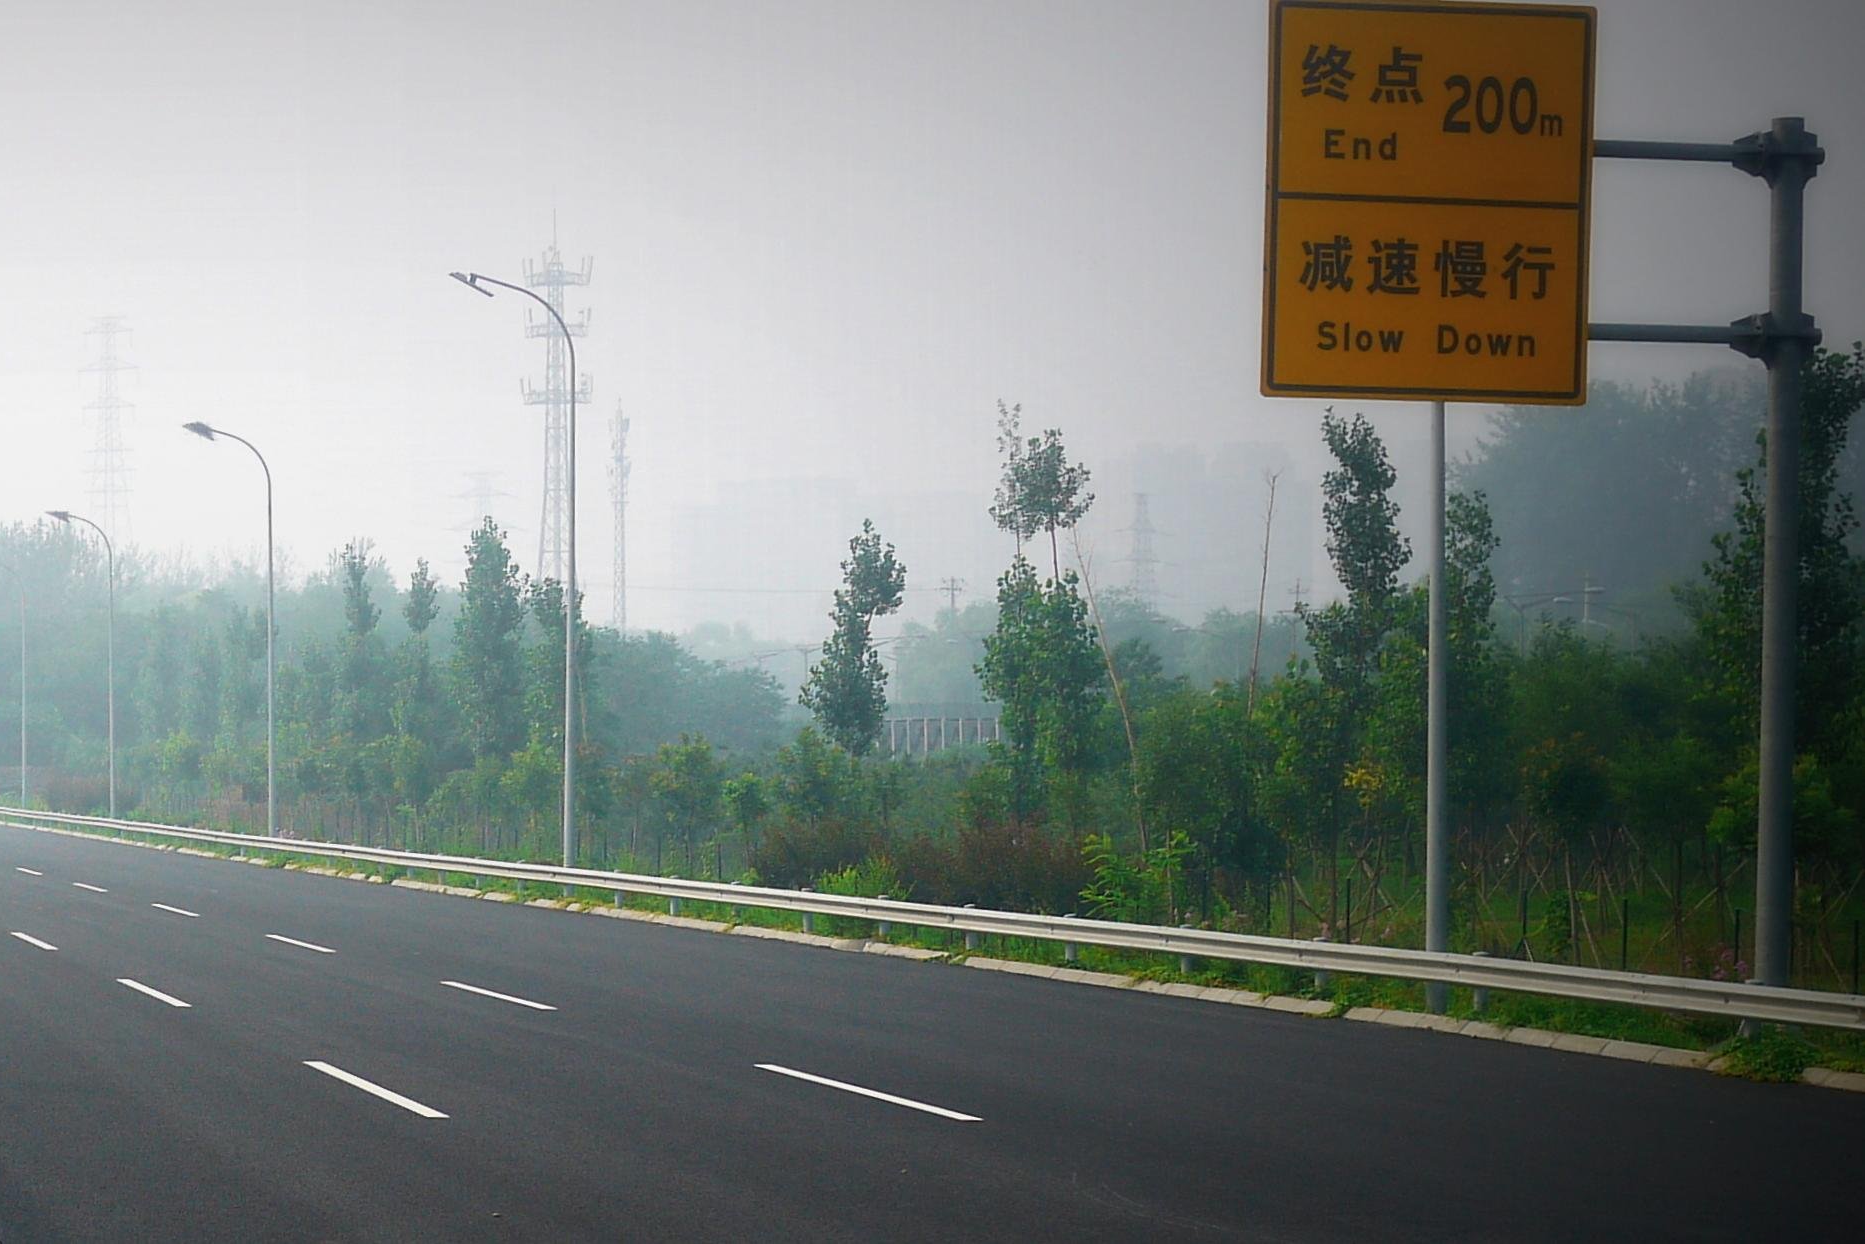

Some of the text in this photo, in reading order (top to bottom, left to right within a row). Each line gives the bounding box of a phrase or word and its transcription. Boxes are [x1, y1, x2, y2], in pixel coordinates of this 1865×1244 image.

[1301, 44, 1425, 104] 终点
[1443, 74, 1563, 137] 200m
[1324, 129, 1398, 161] End
[1299, 235, 1555, 300] 减速慢行
[1317, 321, 1536, 357] Slow Down
